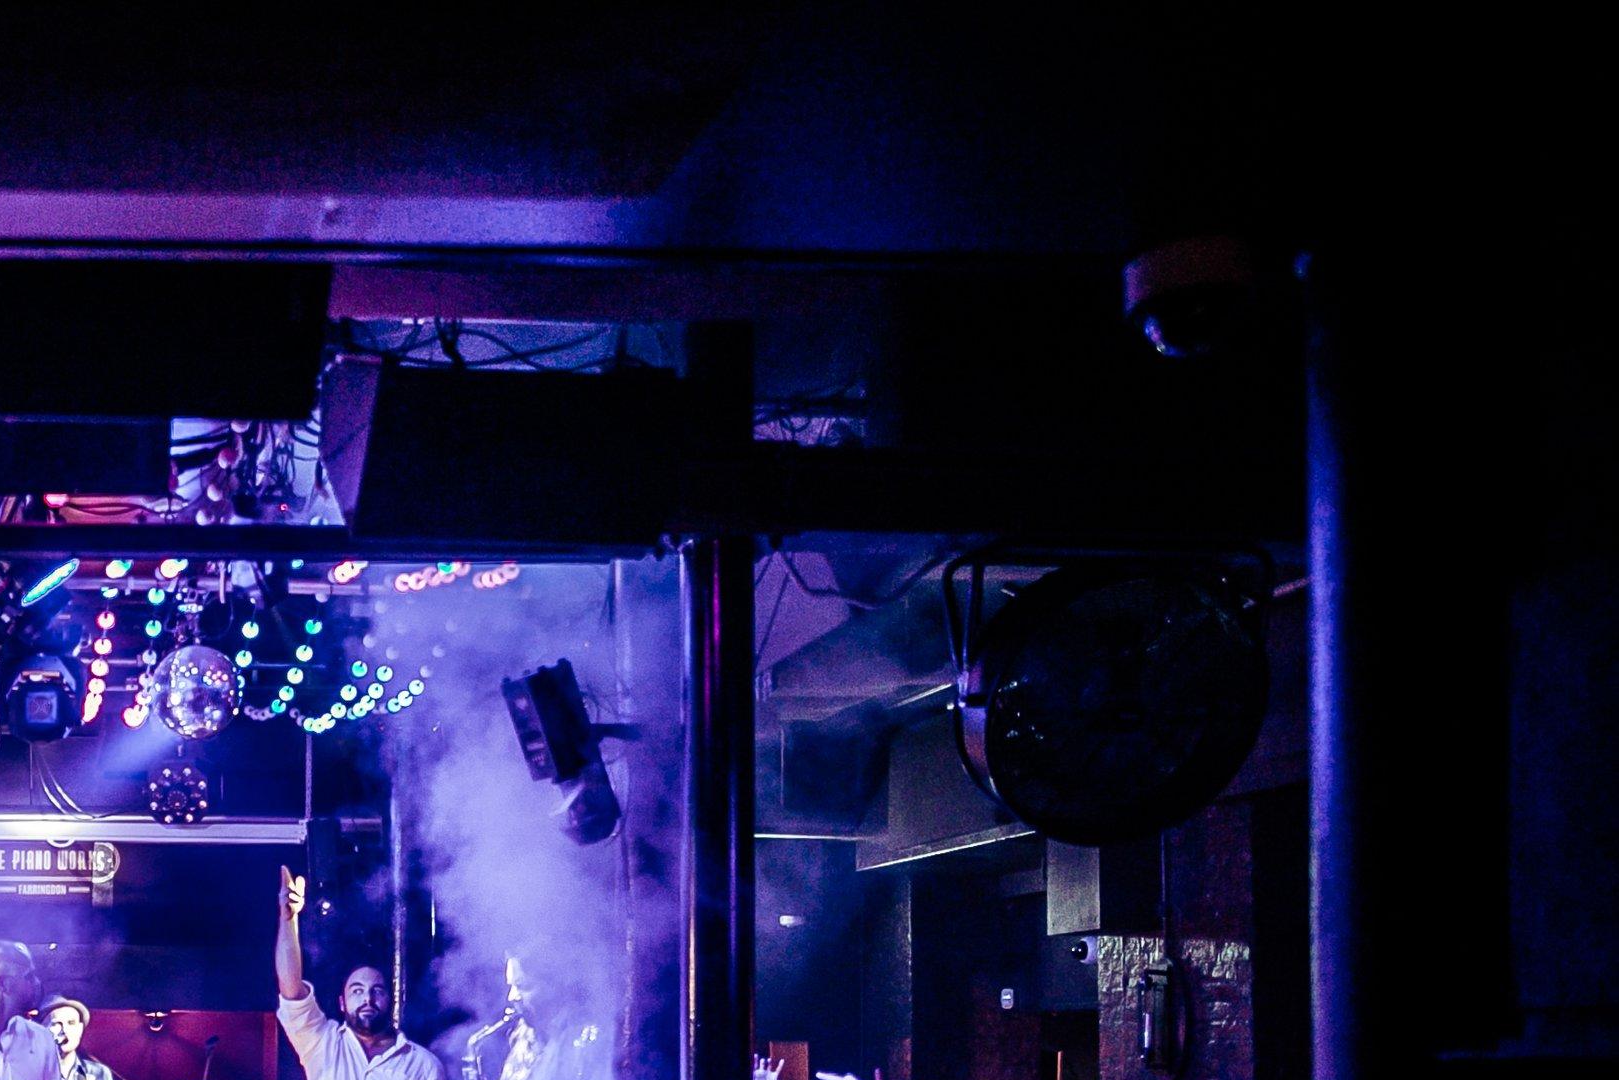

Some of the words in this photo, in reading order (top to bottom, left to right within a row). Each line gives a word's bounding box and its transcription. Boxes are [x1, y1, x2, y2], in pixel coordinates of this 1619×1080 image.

[12, 850, 51, 870] PIANO
[57, 850, 105, 871] WORKS
[18, 884, 67, 895] FARRINGDON
